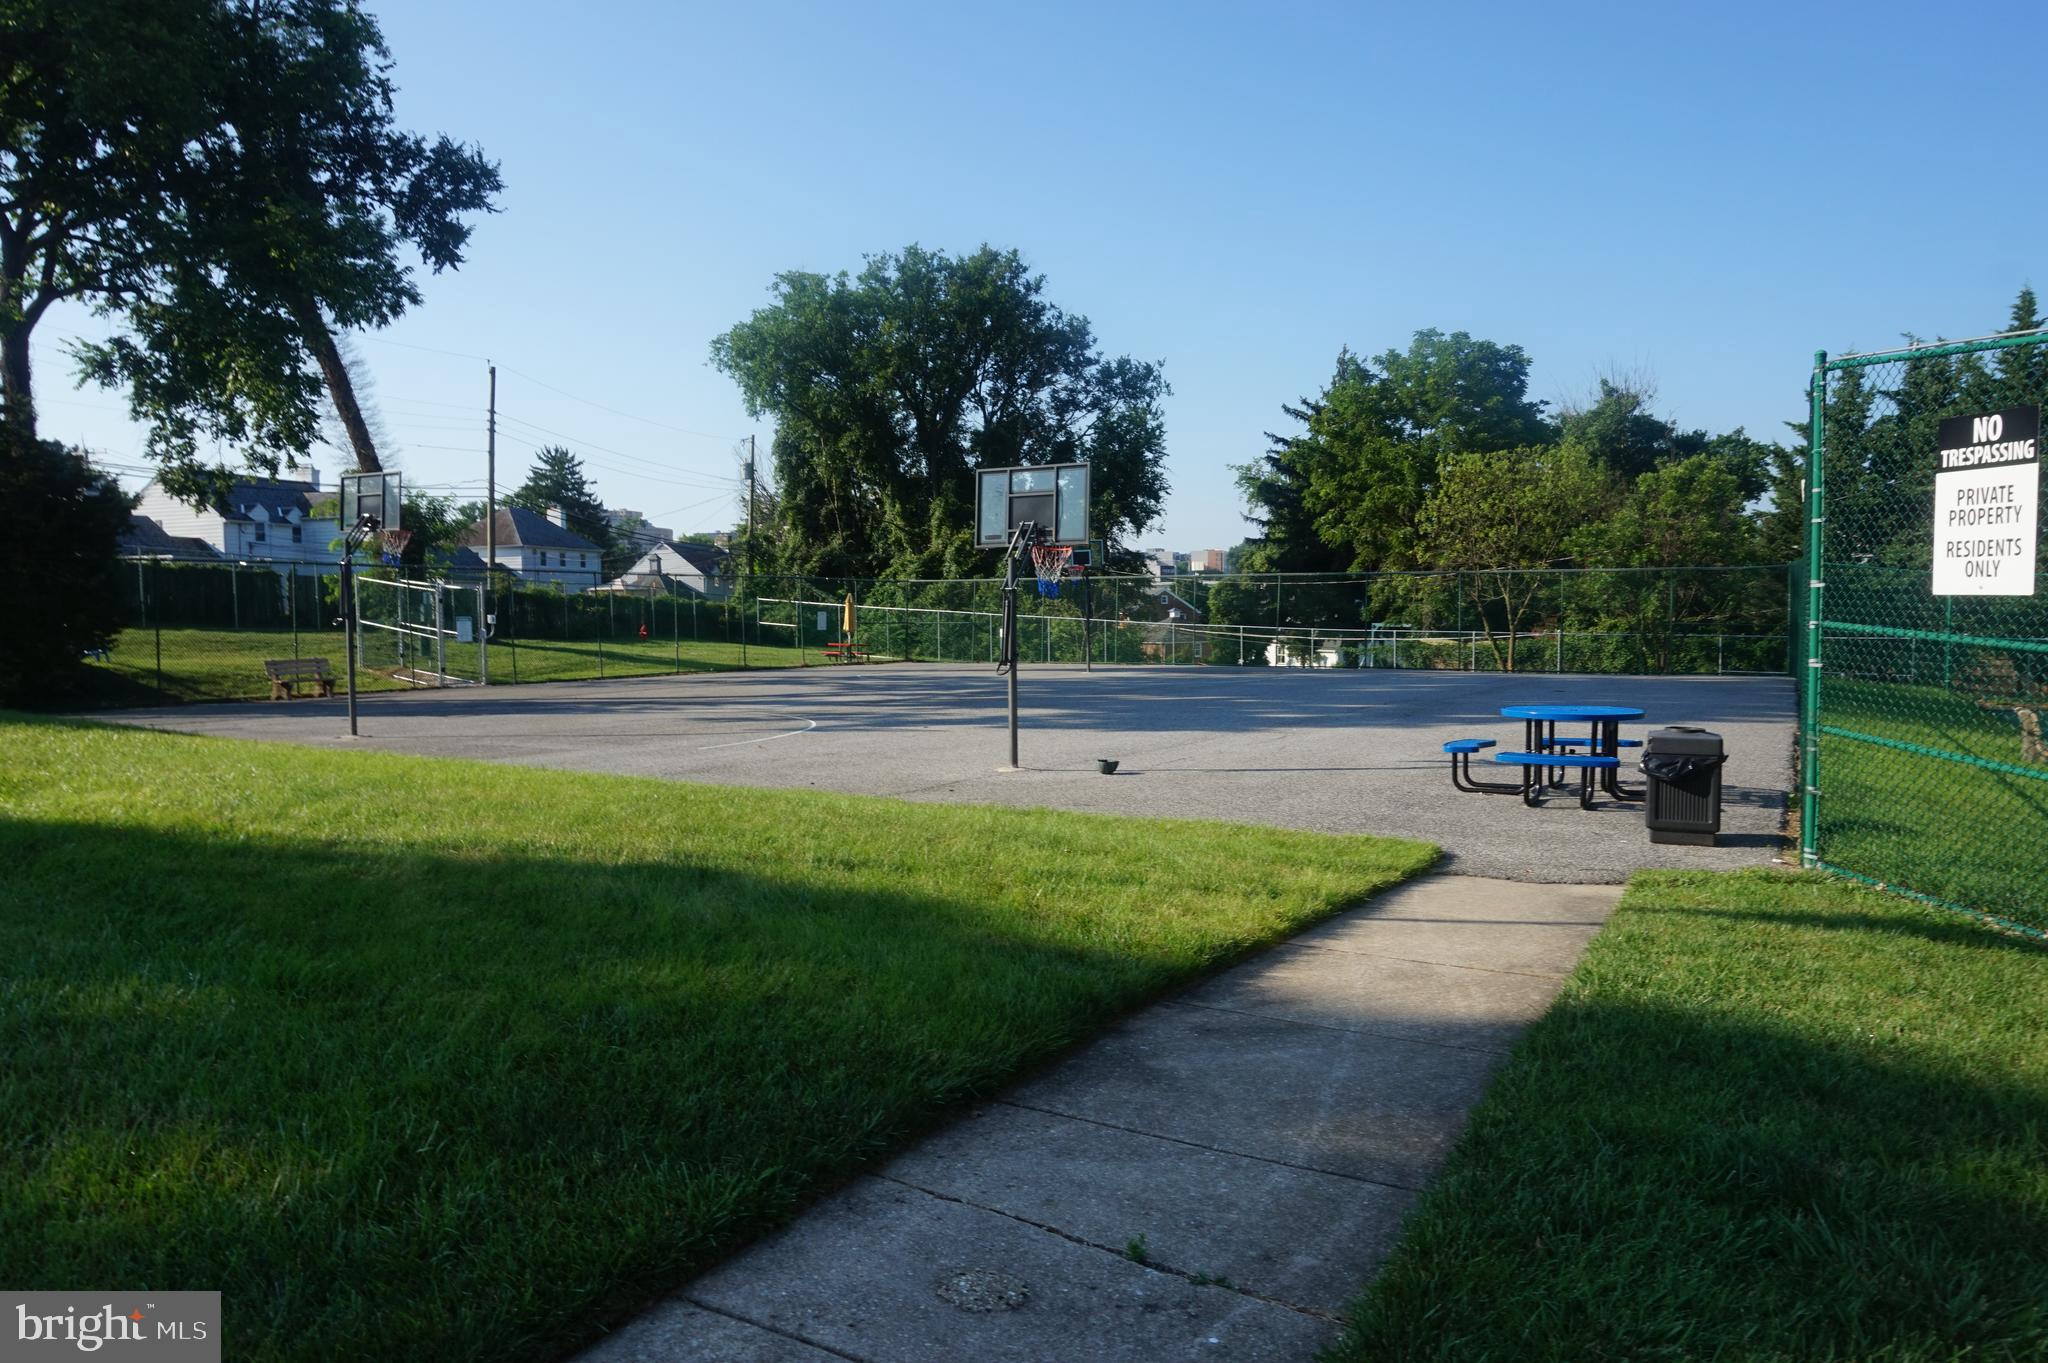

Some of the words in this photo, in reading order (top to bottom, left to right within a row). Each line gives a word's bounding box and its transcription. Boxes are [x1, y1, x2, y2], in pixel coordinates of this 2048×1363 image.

[1973, 414, 2003, 443] NO
[1940, 439, 2035, 468] TRESPASSING
[1957, 485, 2014, 506] PRIVATE
[1949, 505, 2022, 527] PROPERTY
[1946, 538, 2022, 558] RESIDENTS
[1965, 560, 2000, 577] ONLY
